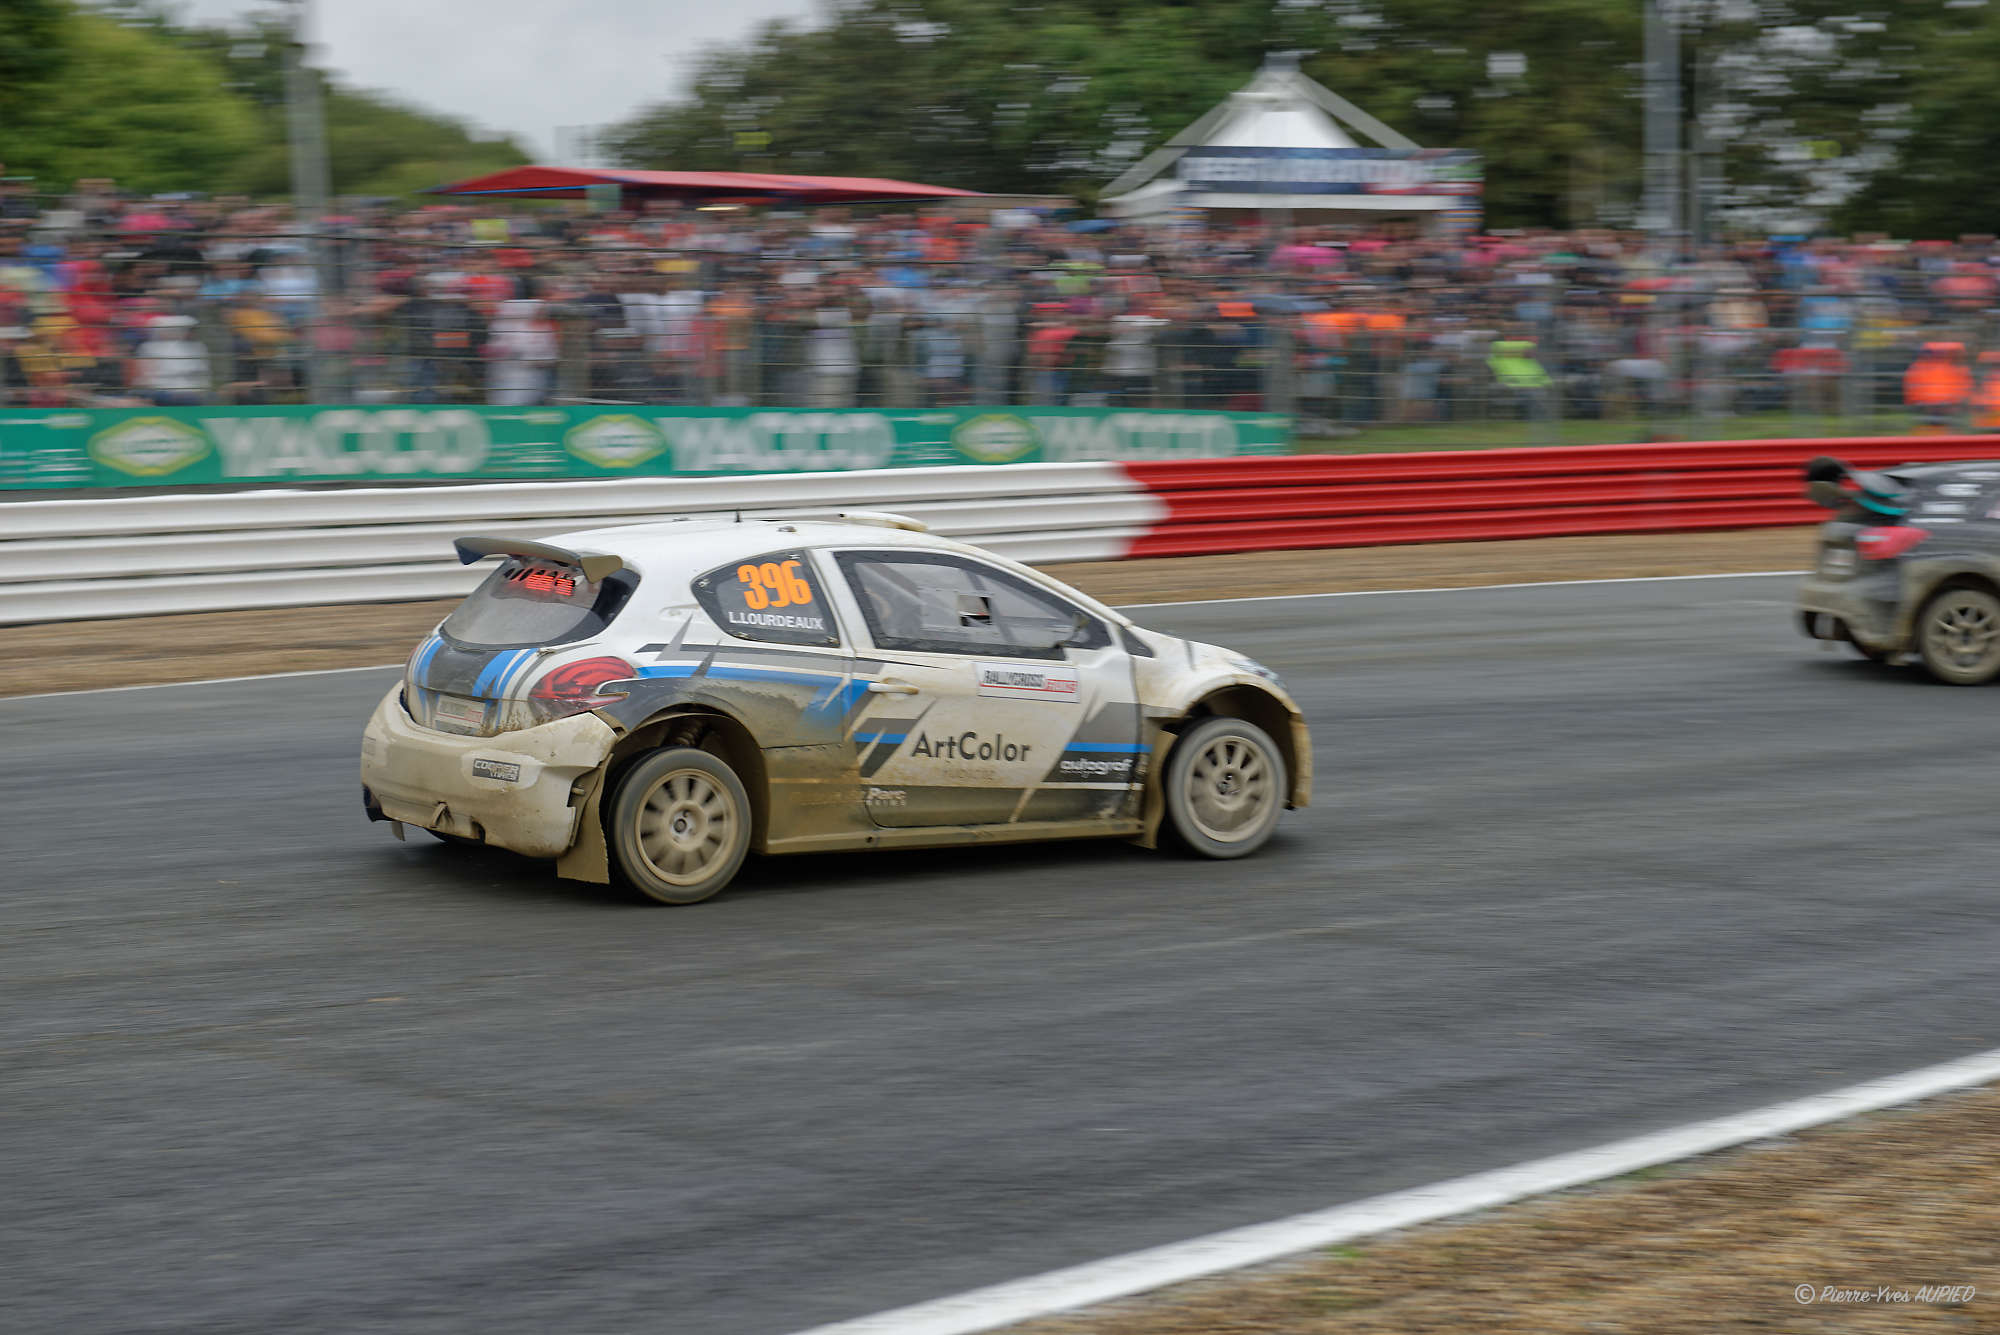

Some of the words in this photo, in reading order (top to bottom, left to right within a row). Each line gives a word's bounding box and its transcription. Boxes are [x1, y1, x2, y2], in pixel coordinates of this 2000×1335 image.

[200, 409, 492, 477] YACCO
[737, 560, 813, 610] 396
[911, 731, 1031, 761] ArtColor
